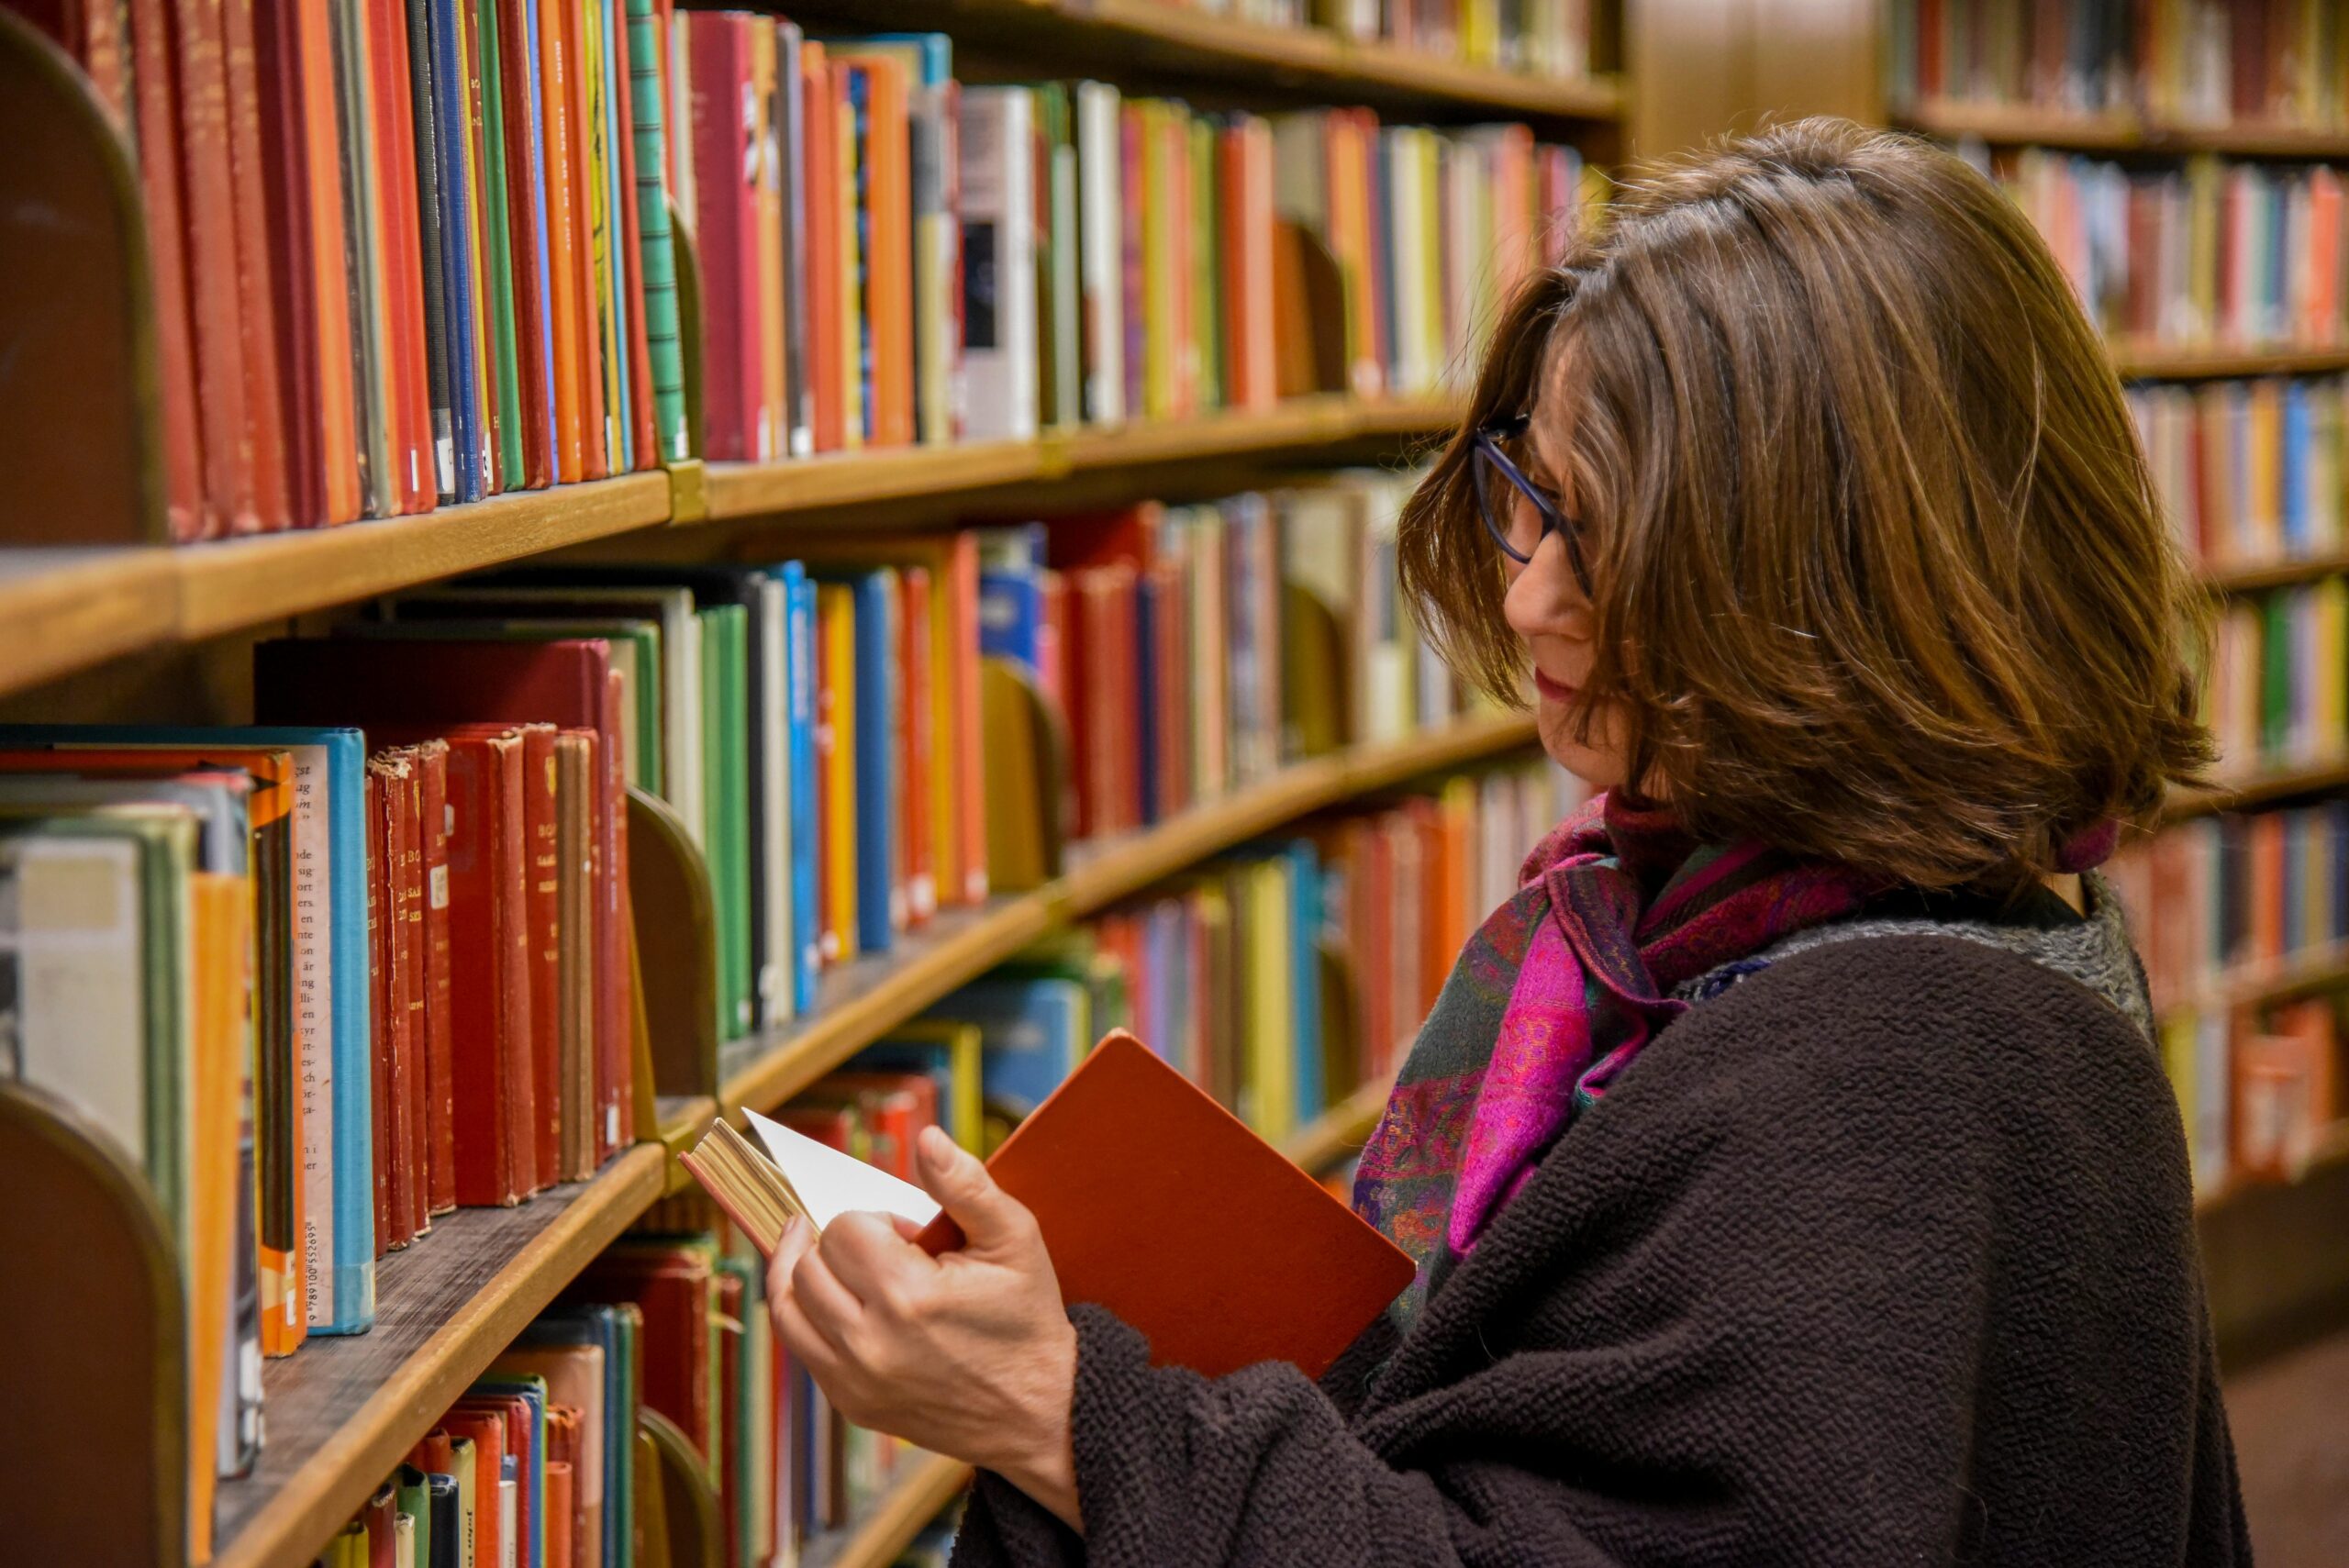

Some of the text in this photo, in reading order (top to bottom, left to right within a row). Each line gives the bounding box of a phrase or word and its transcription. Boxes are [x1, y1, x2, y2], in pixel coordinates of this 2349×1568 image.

[303, 962, 314, 971] är
[307, 1226, 317, 1263] 552695
[308, 1268, 317, 1307] 789100
